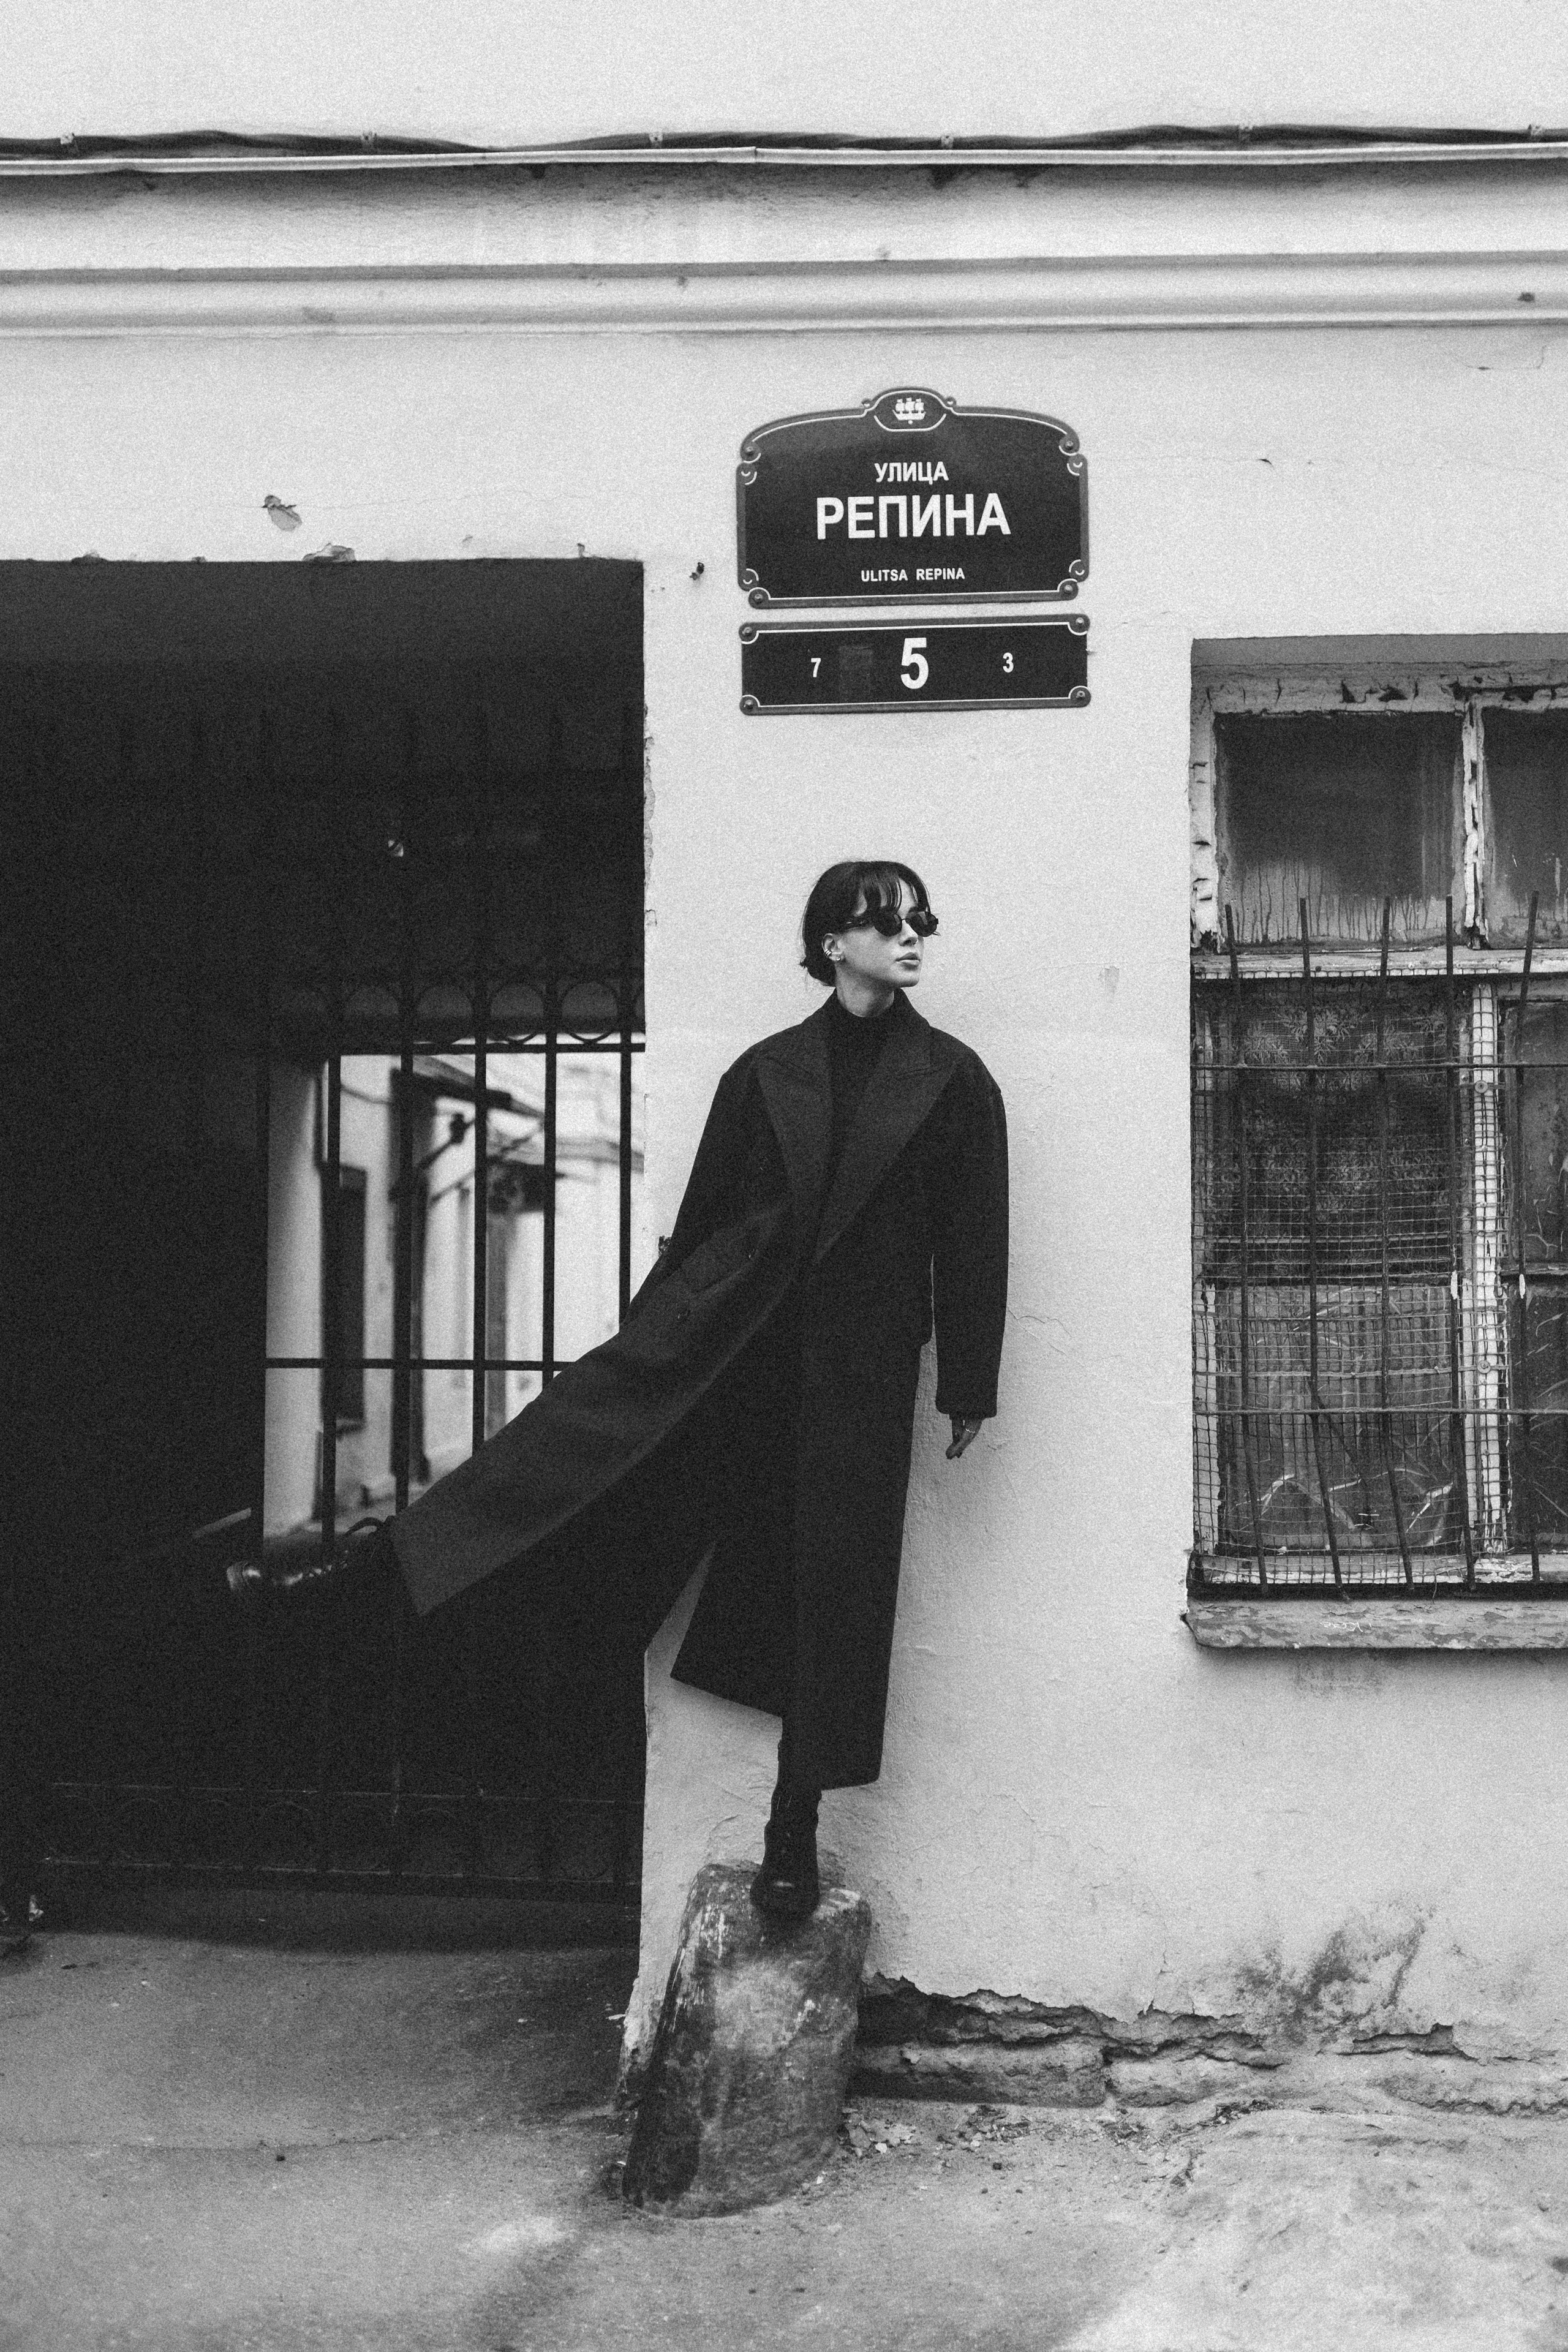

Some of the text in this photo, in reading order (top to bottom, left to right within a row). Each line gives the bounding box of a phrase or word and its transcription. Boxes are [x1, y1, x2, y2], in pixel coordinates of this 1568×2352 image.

[874, 461, 949, 485] УЛИЦА
[816, 493, 1011, 540] РЕПИНА
[861, 567, 965, 582] ULITSA REPINA
[810, 637, 1014, 690] 7 5 3
